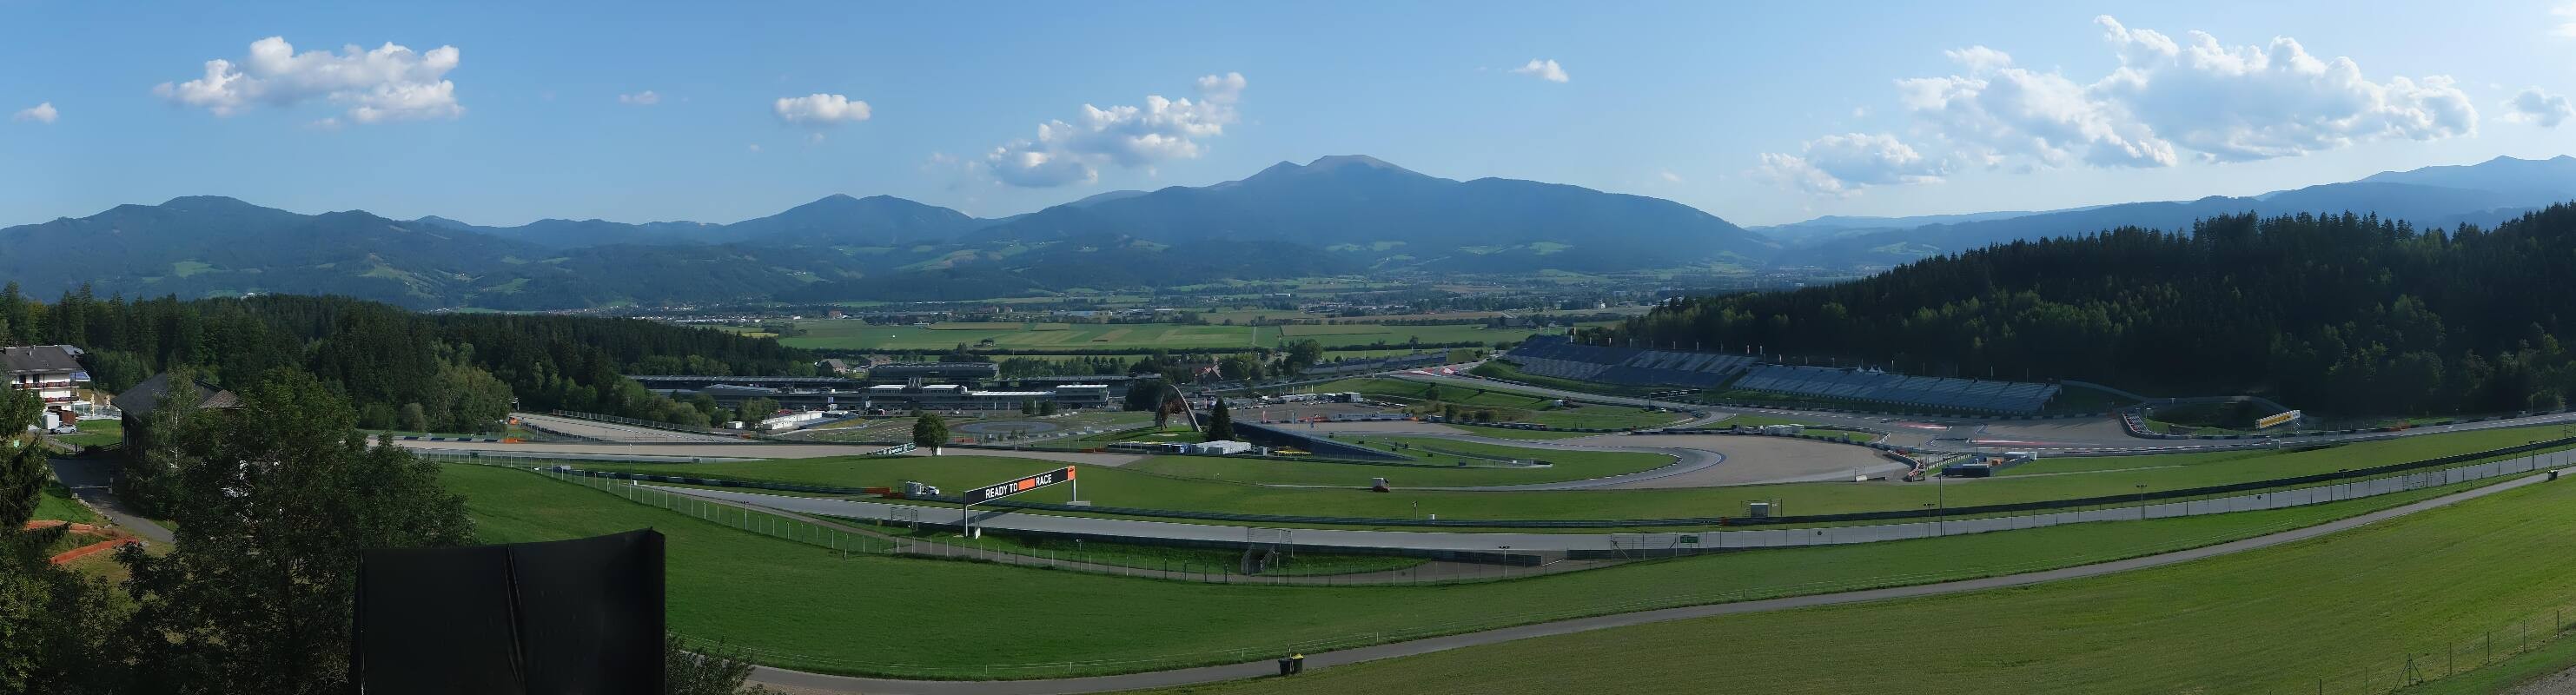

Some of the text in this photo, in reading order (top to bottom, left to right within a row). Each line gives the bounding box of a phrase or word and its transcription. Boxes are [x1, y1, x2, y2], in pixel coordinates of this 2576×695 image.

[985, 474, 1052, 499] READY TO RACE
